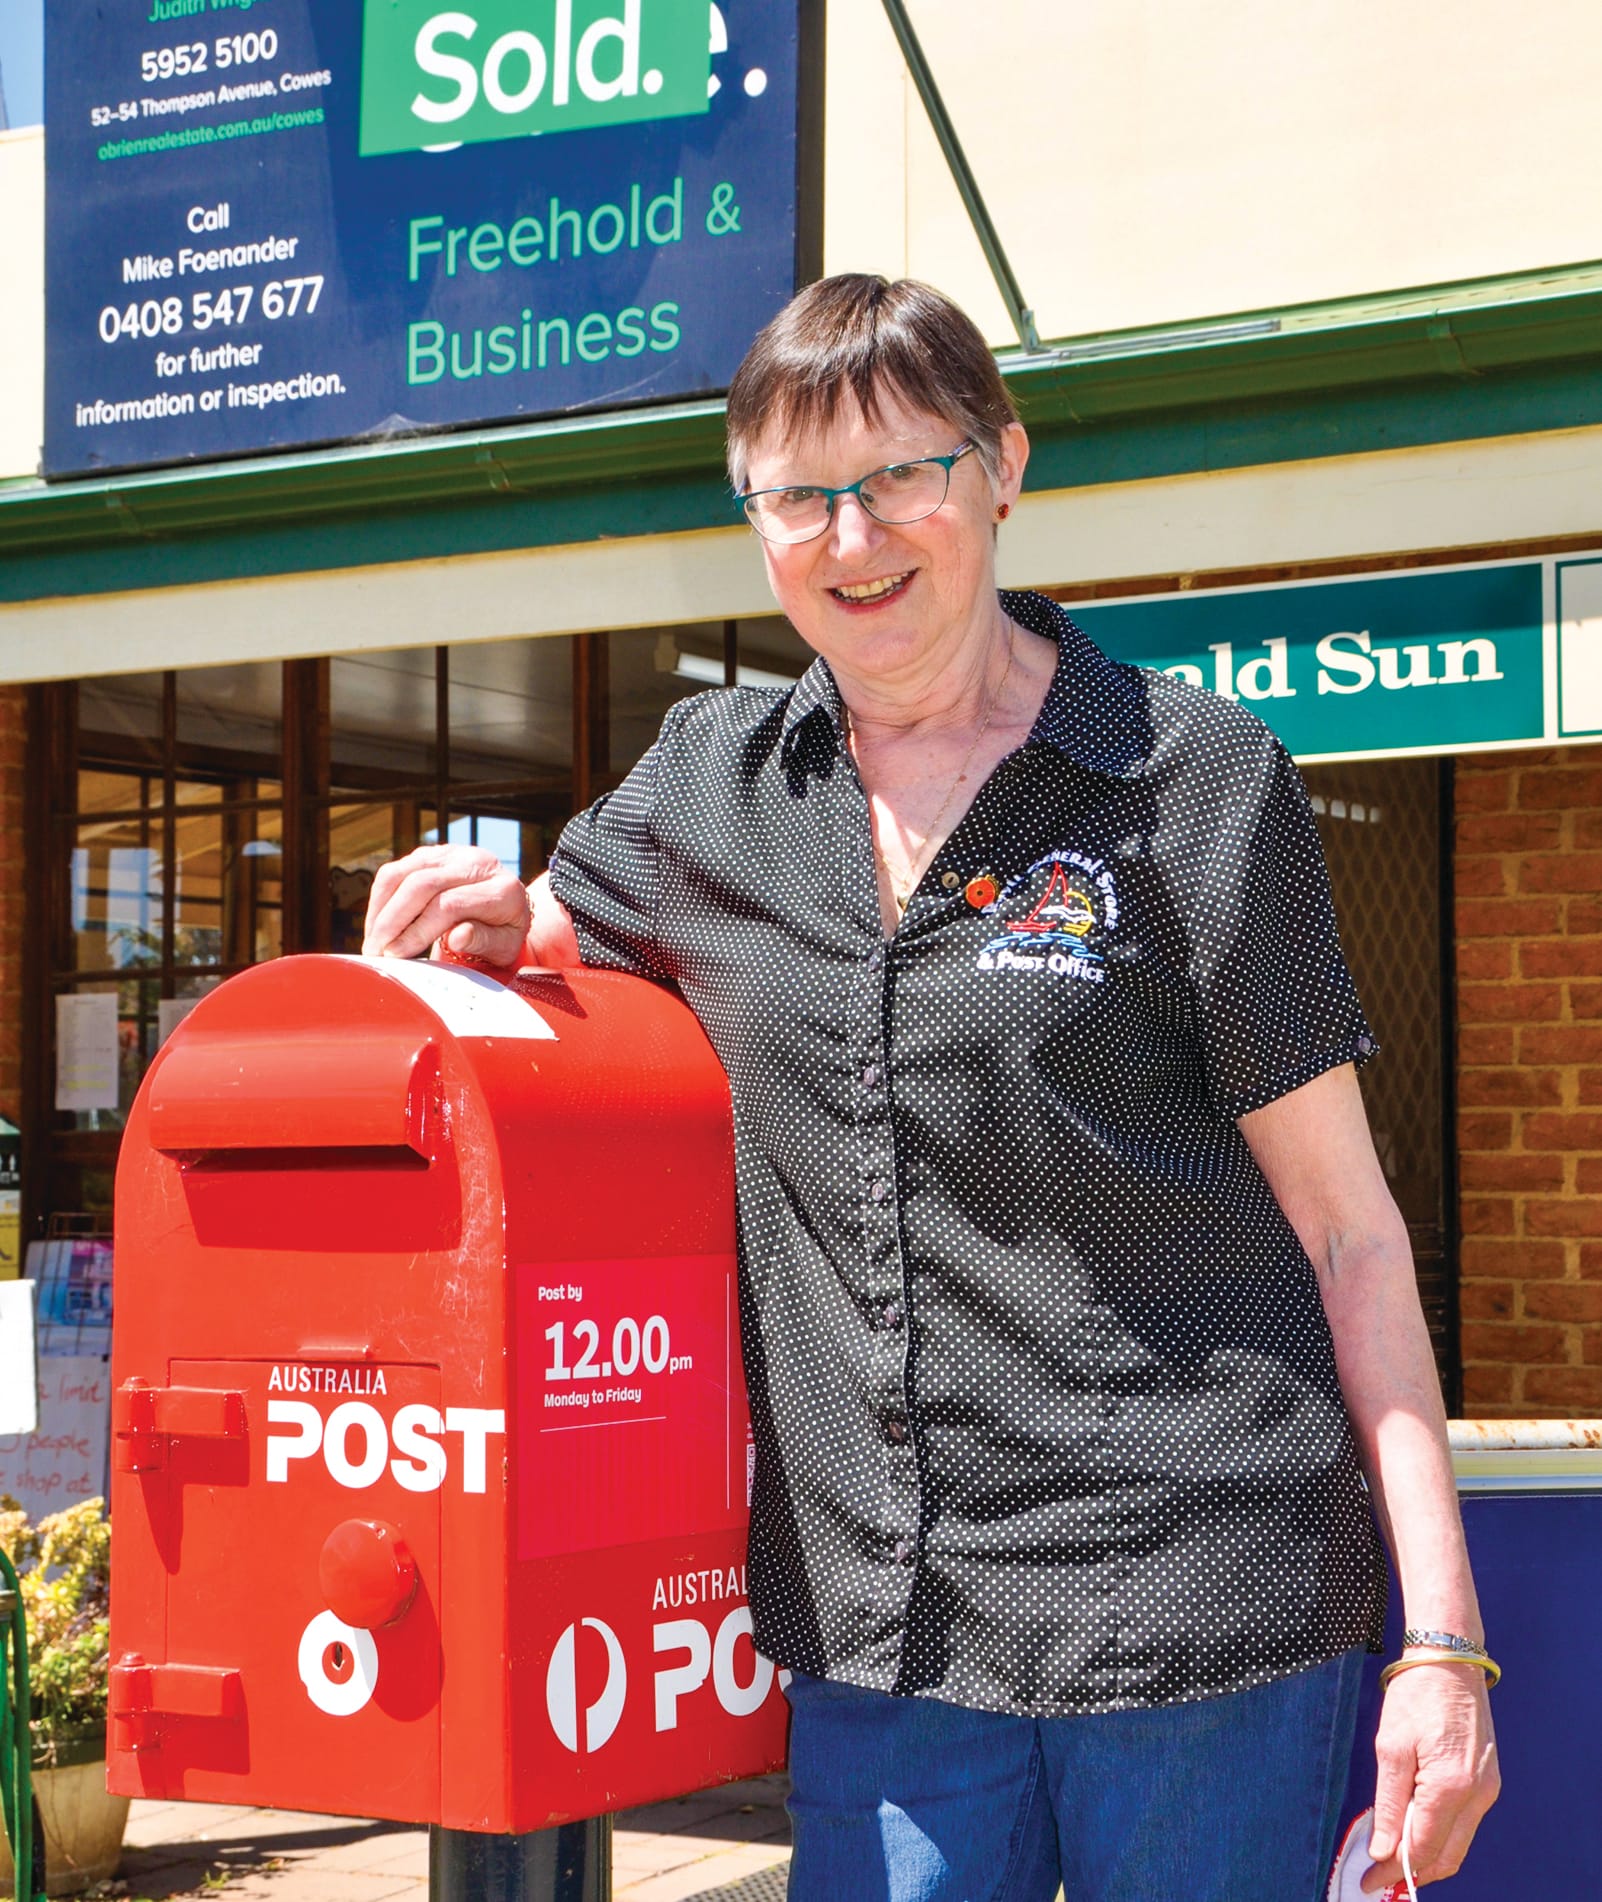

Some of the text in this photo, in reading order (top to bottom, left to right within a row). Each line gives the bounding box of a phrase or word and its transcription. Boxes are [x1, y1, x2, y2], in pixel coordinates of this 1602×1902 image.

[141, 28, 278, 82] 5952 5100
[410, 0, 663, 123] Sold.
[141, 90, 215, 116] Thompson
[217, 81, 278, 104] Avenue,
[280, 69, 332, 92] Cowes
[97, 107, 325, 160] obrienrealestate.com.au/cowes
[187, 203, 230, 234] Call
[408, 177, 742, 282] Freehold &
[122, 235, 299, 284] Mike Foenander
[98, 275, 325, 344] 0408 547 677
[155, 342, 263, 378] for further
[407, 301, 682, 386] Business
[75, 372, 347, 428] information or inspection.
[1315, 629, 1504, 696] Sun
[538, 1284, 583, 1302] Post by
[268, 1366, 388, 1395] AUSTRALIA
[544, 1387, 642, 1408] Monday to Friday
[266, 1400, 505, 1494] POST
[652, 1565, 748, 1611] AUSTRAL
[653, 1606, 793, 1733] PO
